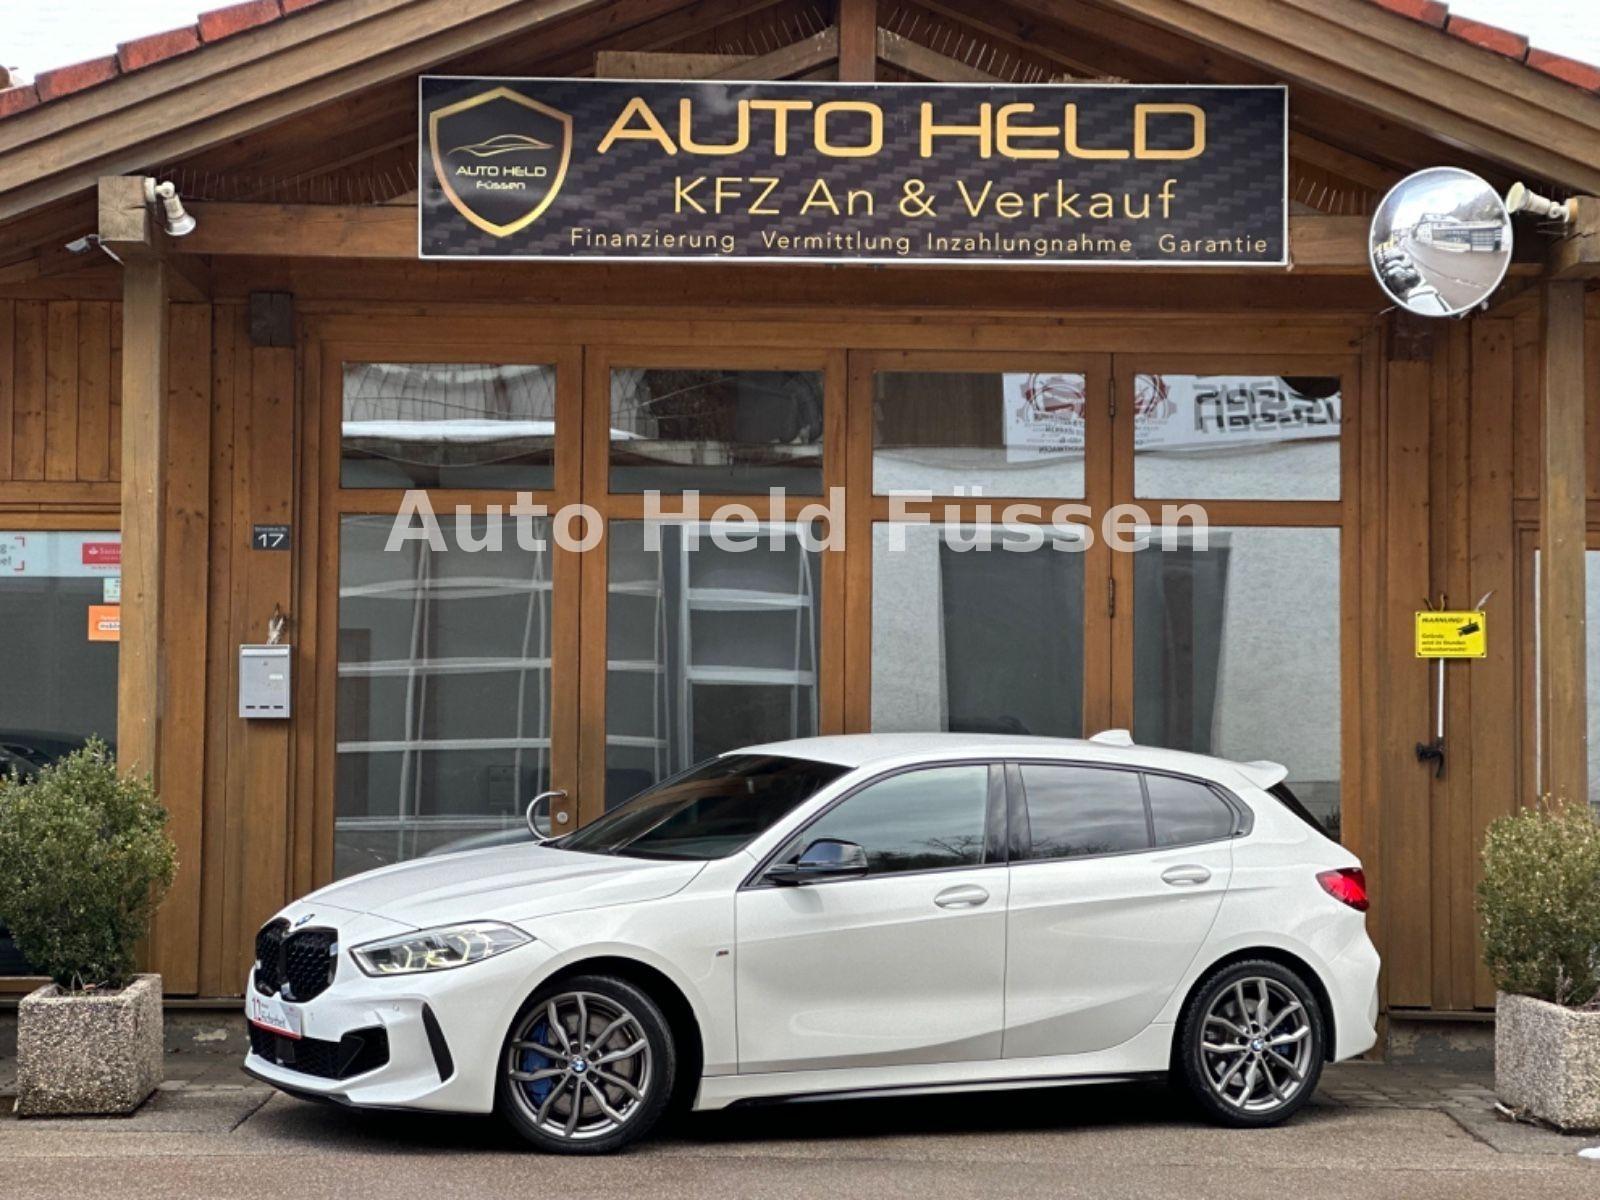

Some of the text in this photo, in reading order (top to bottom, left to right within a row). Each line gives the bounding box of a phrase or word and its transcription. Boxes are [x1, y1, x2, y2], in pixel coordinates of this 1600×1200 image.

[597, 96, 1207, 161] AUTO HELD
[455, 165, 547, 177] AUTO HELD
[674, 176, 1177, 219] KFZ An & Verkauf
[570, 227, 1268, 257] Finanzierung Vermittlung Inzahlungnahme Garantie
[257, 533, 285, 548] 17
